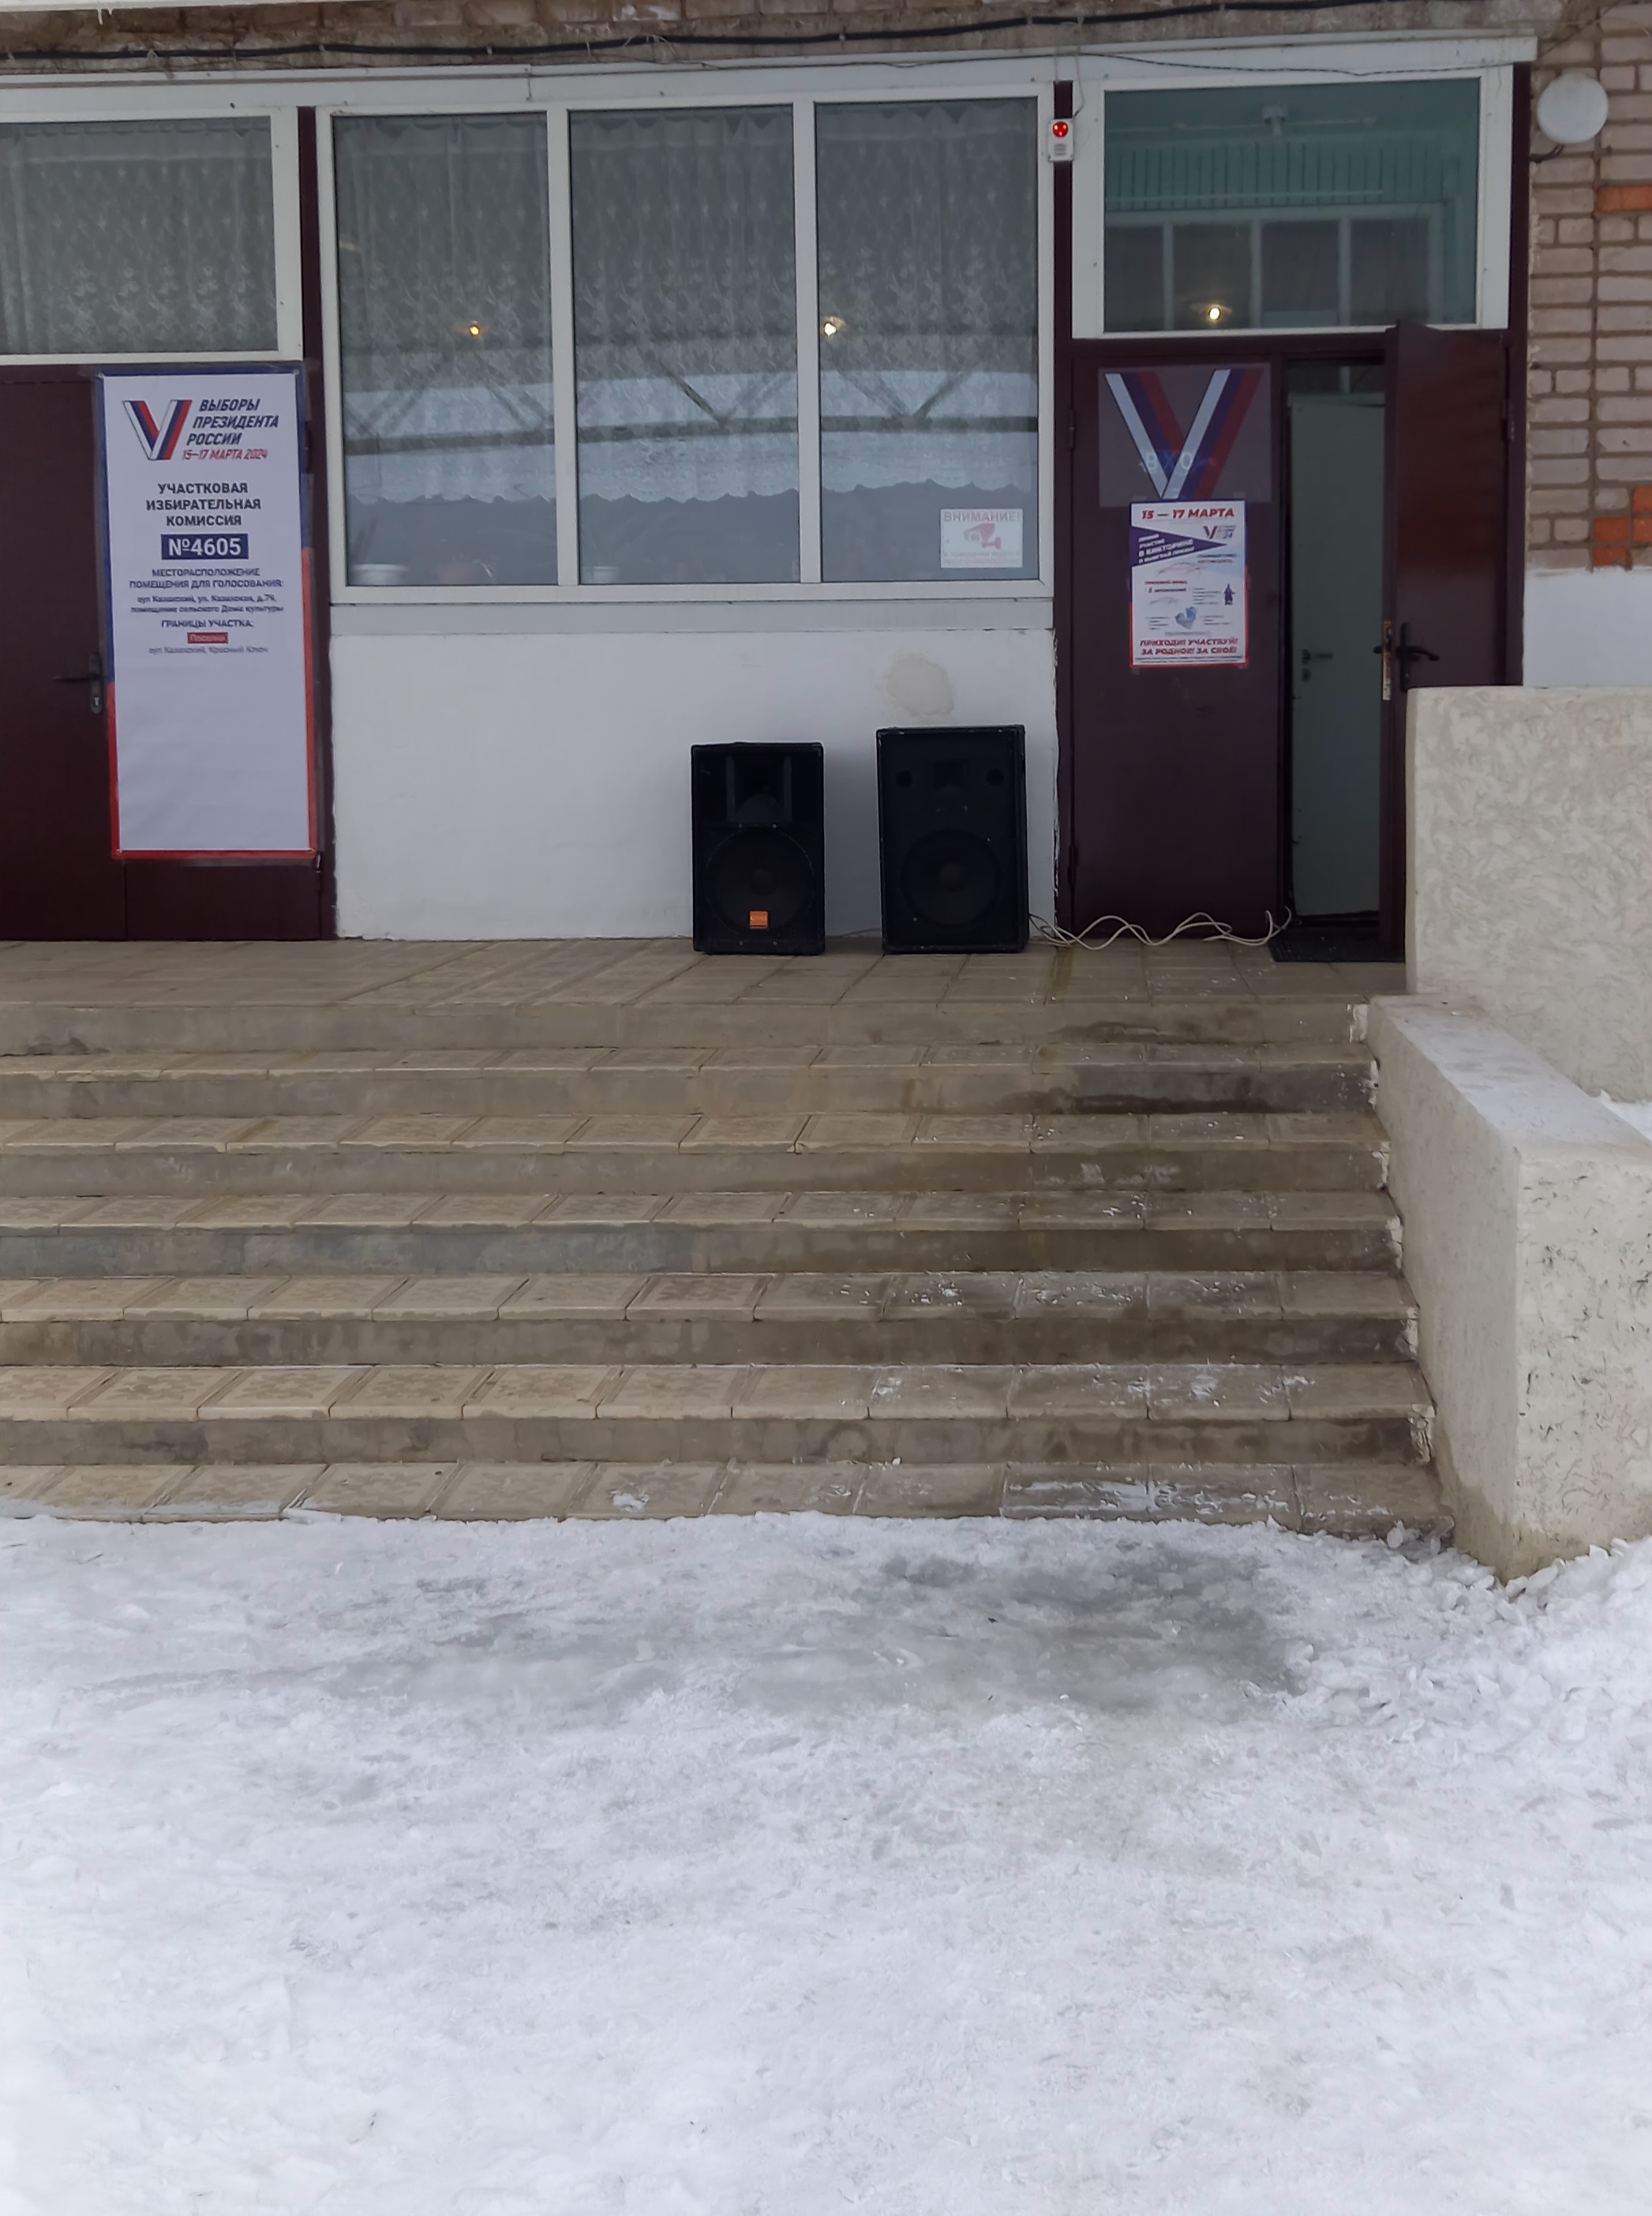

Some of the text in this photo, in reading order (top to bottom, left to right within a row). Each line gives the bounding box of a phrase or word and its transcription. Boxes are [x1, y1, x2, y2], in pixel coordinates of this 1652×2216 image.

[199, 398, 261, 412] ВЫБОРЫ
[192, 414, 279, 429] ПРЕЗИДЕНТА
[185, 432, 243, 446] РОССИИ
[209, 448, 243, 459] МАРТА
[243, 448, 268, 459] 2024
[158, 482, 249, 495] УЧАСТКОВАЯ
[146, 498, 262, 511] ИЗБИРАТЕЛЬНАЯ
[1142, 509, 1155, 519] 15
[1172, 508, 1186, 519] 17
[1188, 507, 1235, 518] МАРТА
[167, 515, 242, 527] КОМИССИЯ
[168, 537, 242, 557] №4605
[152, 568, 261, 577] МЕСТОРАСПОЛОЖЕНИЕ
[129, 579, 189, 590] ПОМЕЩЕНИЯ
[191, 579, 211, 590] ДЛЯ
[161, 619, 207, 629] ГРАНИЦЫ
